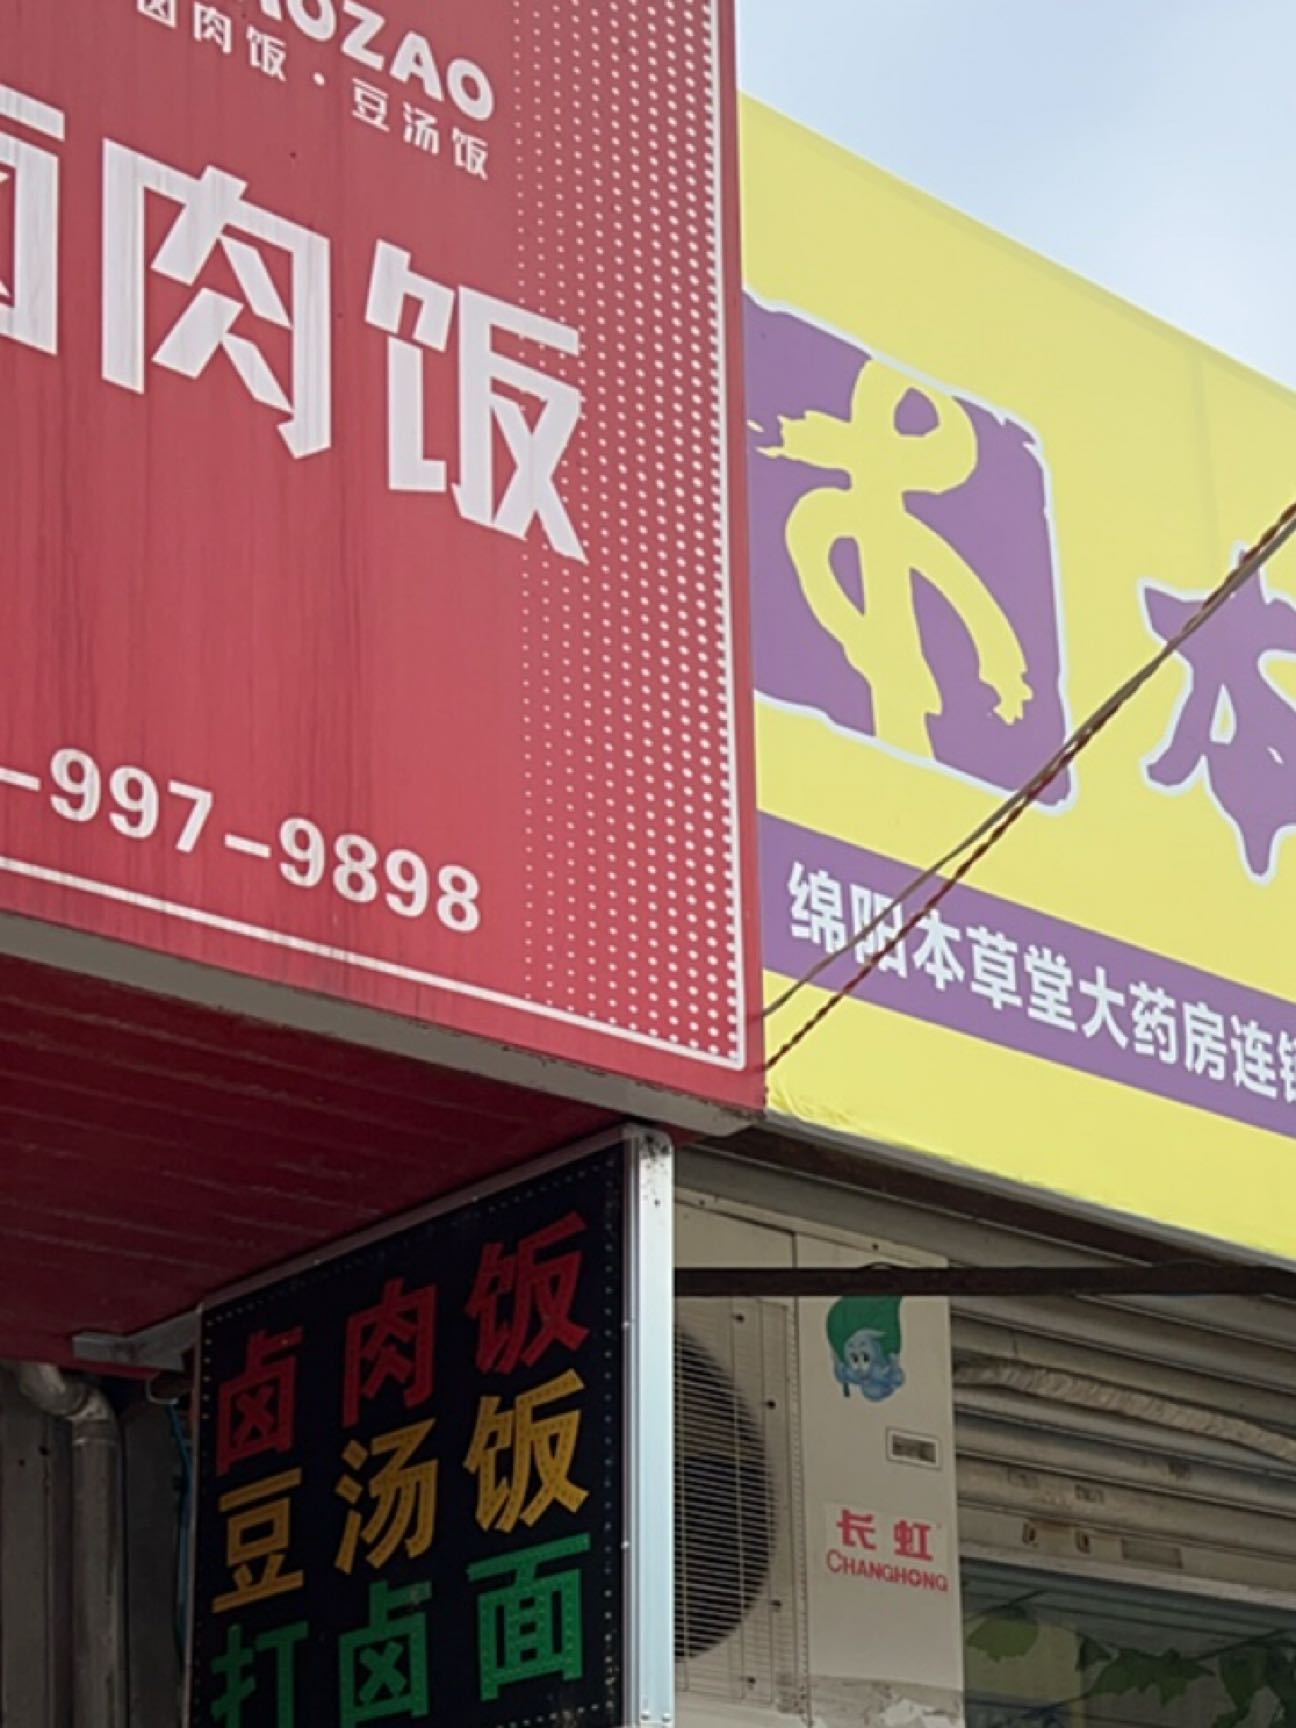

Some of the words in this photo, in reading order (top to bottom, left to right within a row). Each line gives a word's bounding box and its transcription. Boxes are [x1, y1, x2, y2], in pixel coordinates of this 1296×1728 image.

[215, 1211, 589, 1475] 卤肉饭
[212, 1369, 590, 1613] 豆汤饭
[836, 1509, 933, 1562] 长虹
[826, 1548, 949, 1592] CHANGHONG
